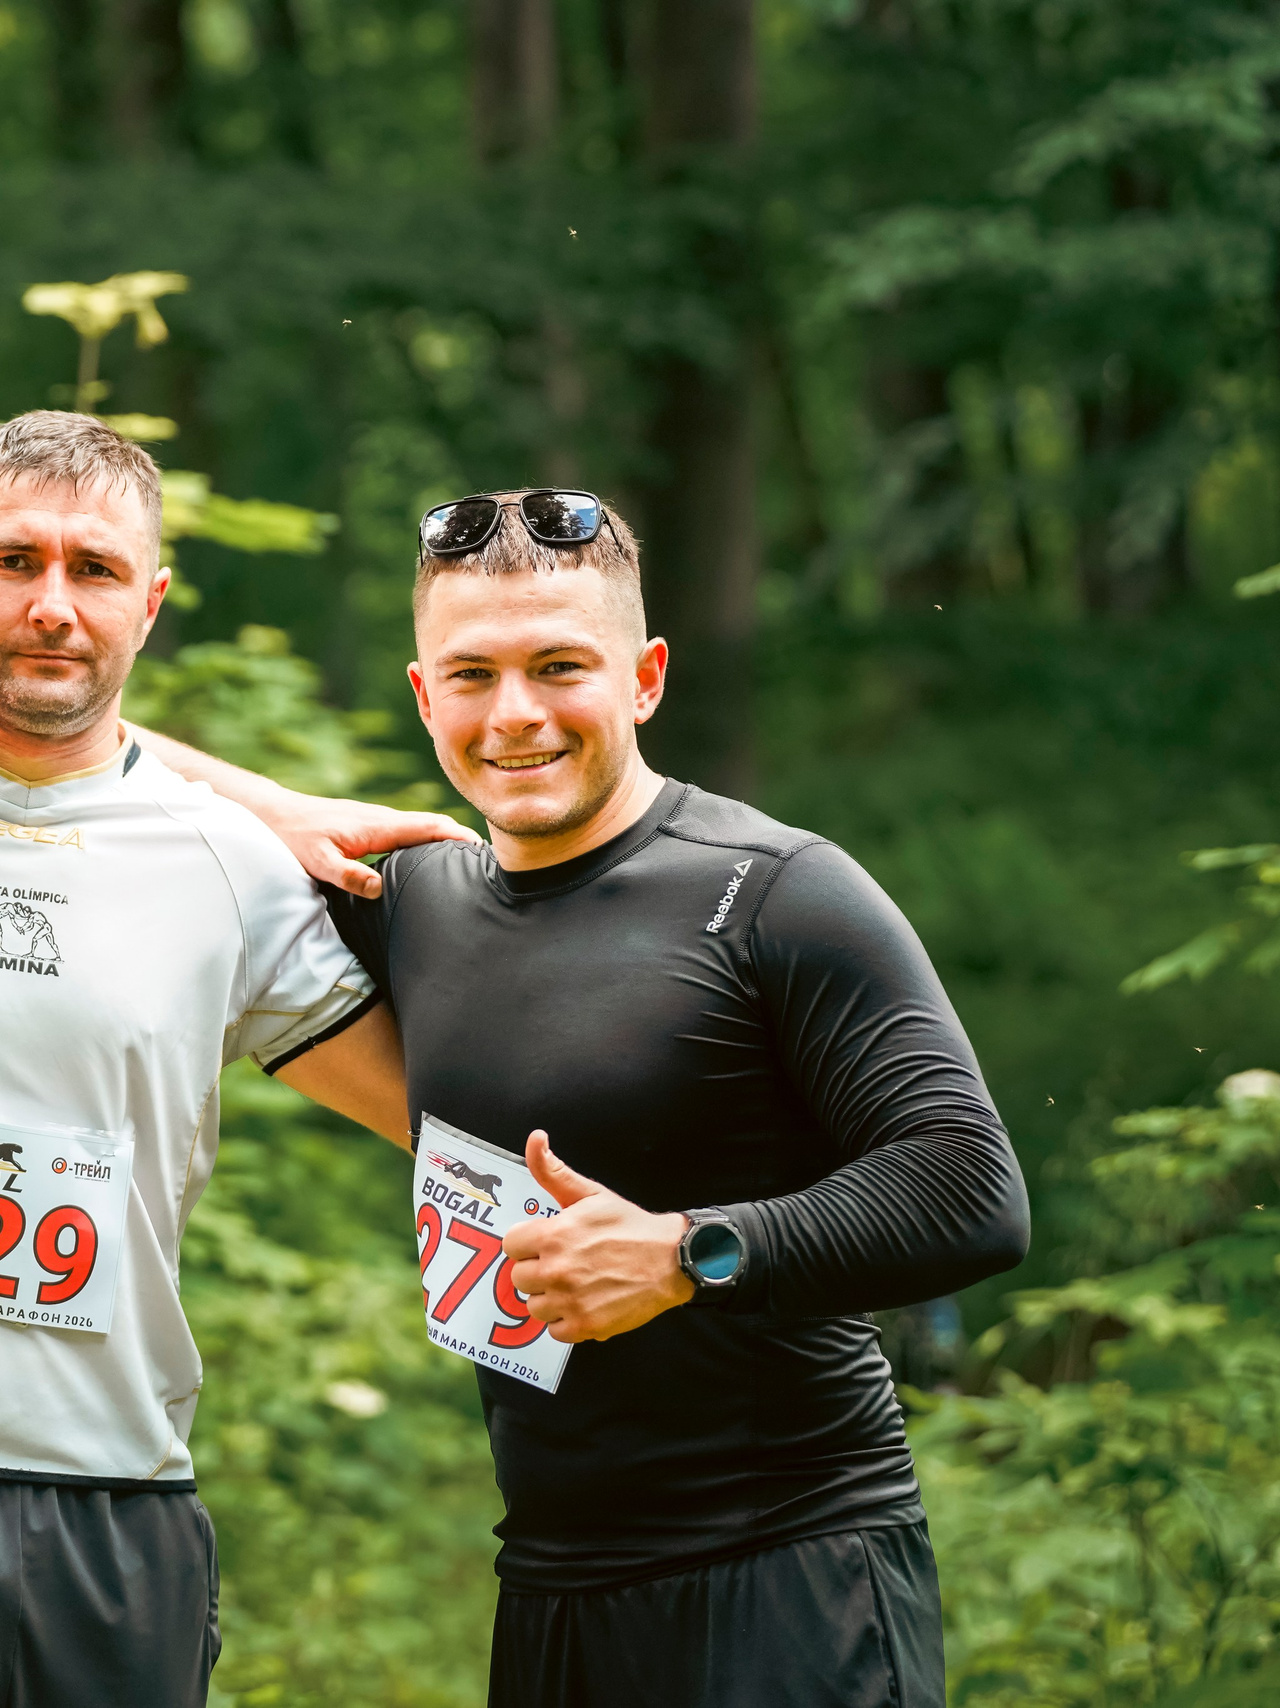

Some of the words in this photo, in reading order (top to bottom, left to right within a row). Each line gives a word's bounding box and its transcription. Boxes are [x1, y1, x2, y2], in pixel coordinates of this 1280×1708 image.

[13, 888, 69, 905] OLÍMPICA
[706, 876, 744, 934] Reebok
[0, 957, 59, 977] MINA
[421, 1176, 494, 1227] BOGAL
[65, 1315, 93, 1328] 2026
[440, 1333, 510, 1369] МАРАФОН
[512, 1363, 539, 1382] 2026
